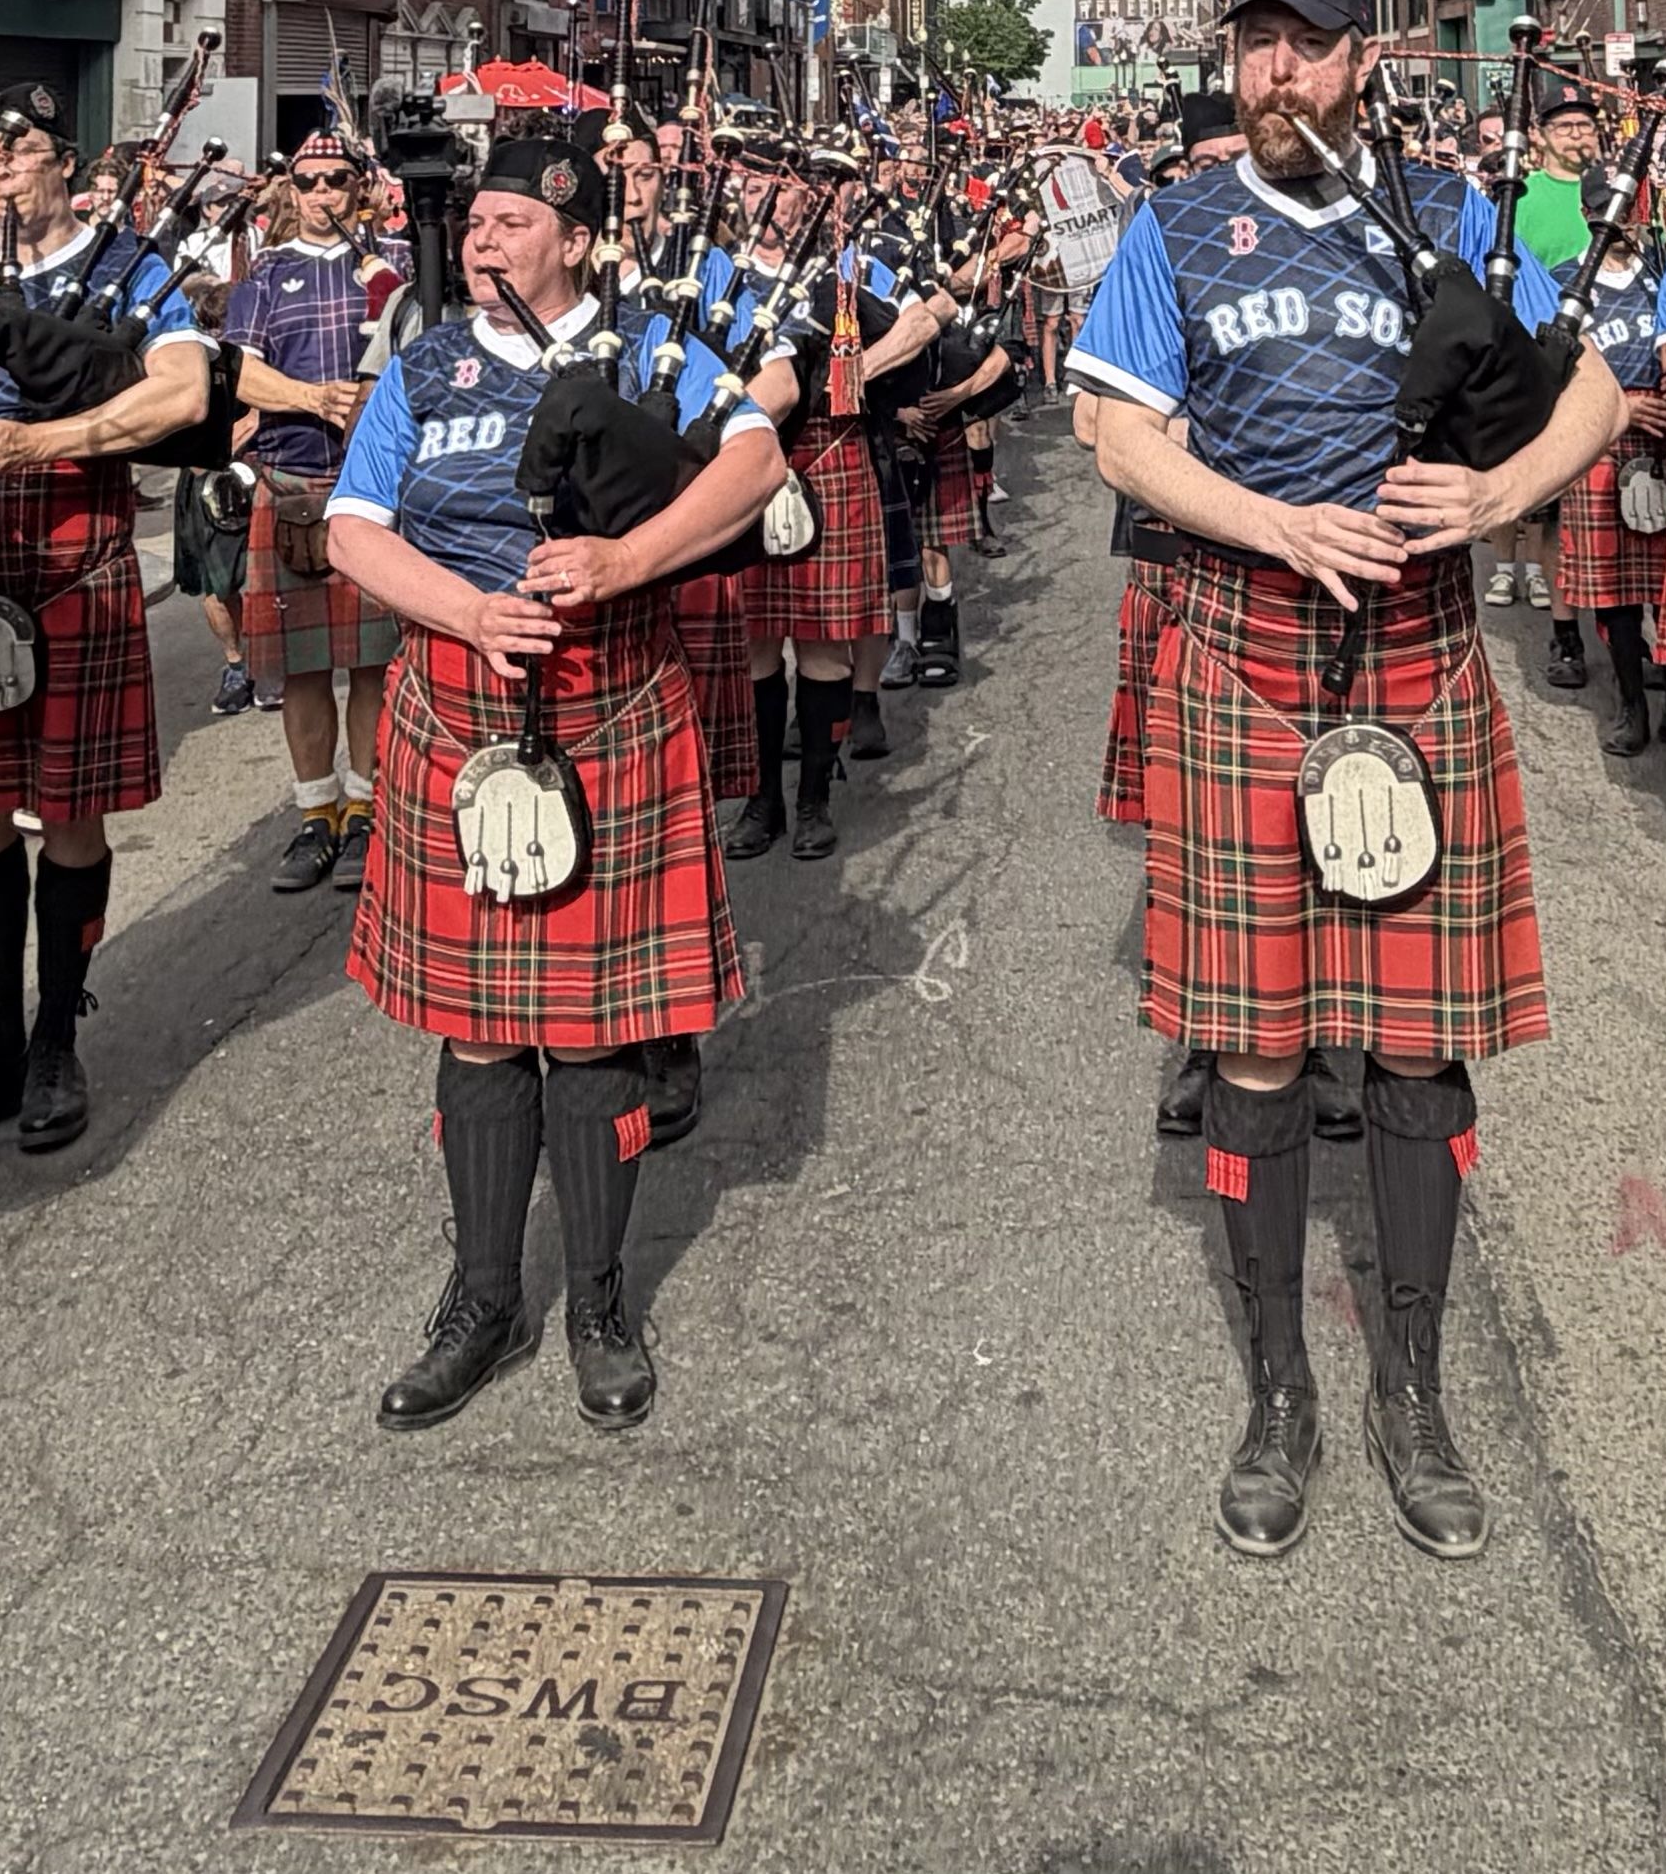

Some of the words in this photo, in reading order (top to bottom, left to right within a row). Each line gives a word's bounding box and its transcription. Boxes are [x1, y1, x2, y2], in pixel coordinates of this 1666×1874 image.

[1053, 204, 1119, 236] STUART
[1227, 215, 1260, 257] B
[1204, 286, 1311, 356] RED
[448, 357, 483, 389] B
[414, 410, 507, 464] RED
[366, 1671, 687, 1724] BWSC
